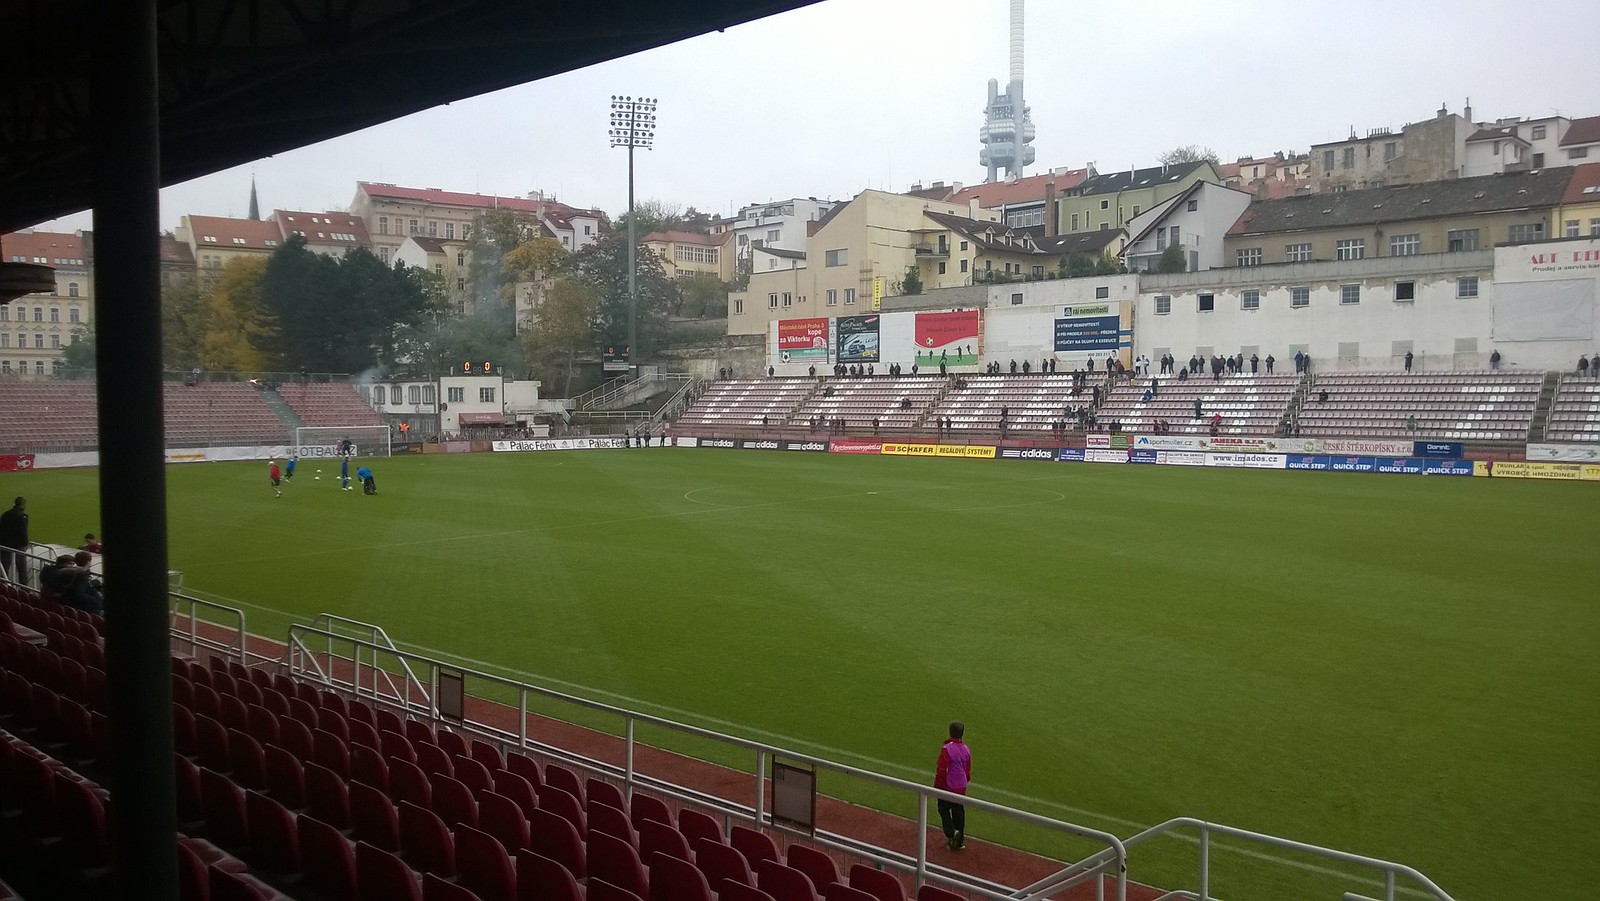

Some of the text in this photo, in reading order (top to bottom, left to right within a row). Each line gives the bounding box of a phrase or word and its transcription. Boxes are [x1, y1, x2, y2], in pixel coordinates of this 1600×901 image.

[465, 361, 490, 370] 0 0
[756, 440, 778, 449] adidas
[801, 442, 824, 450] adidas
[1322, 441, 1345, 450] ČESKÉ
[1021, 449, 1052, 458] adidas
